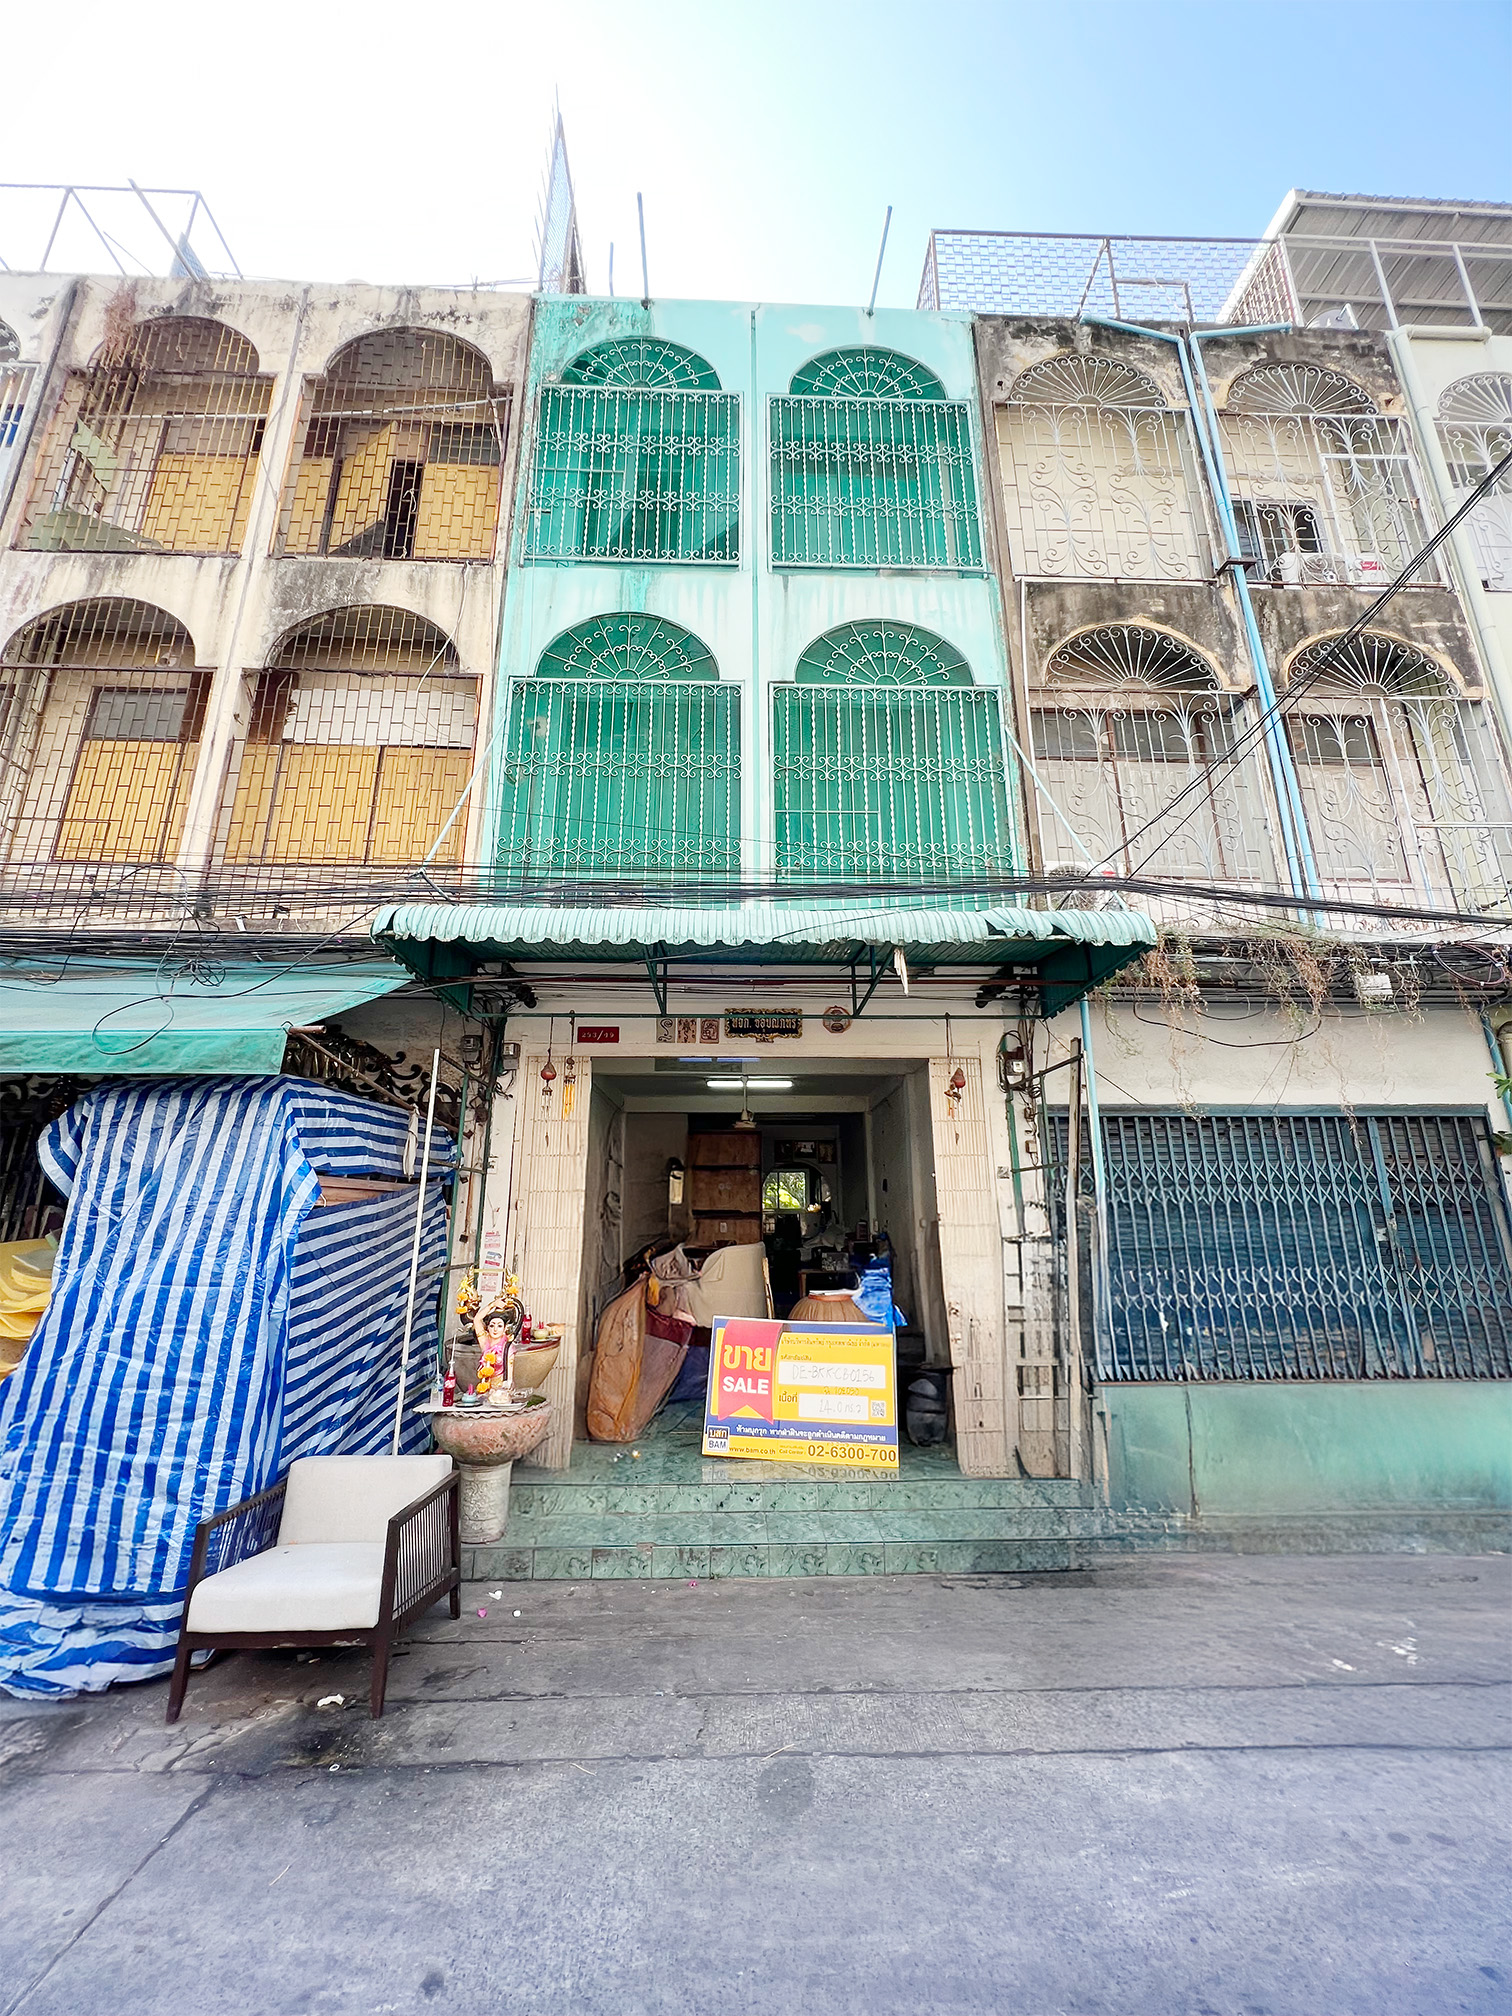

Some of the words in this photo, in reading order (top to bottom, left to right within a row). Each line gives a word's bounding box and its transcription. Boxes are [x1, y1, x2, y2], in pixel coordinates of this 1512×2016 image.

[723, 1345, 771, 1371] ขาย
[723, 1376, 769, 1394] SALE
[779, 1391, 798, 1403] เนื้อที่
[709, 1428, 727, 1438] บสก
[708, 1439, 727, 1449] BAM
[728, 1446, 776, 1455] www.bam.co.th
[808, 1445, 896, 1462] 02-6300-700
